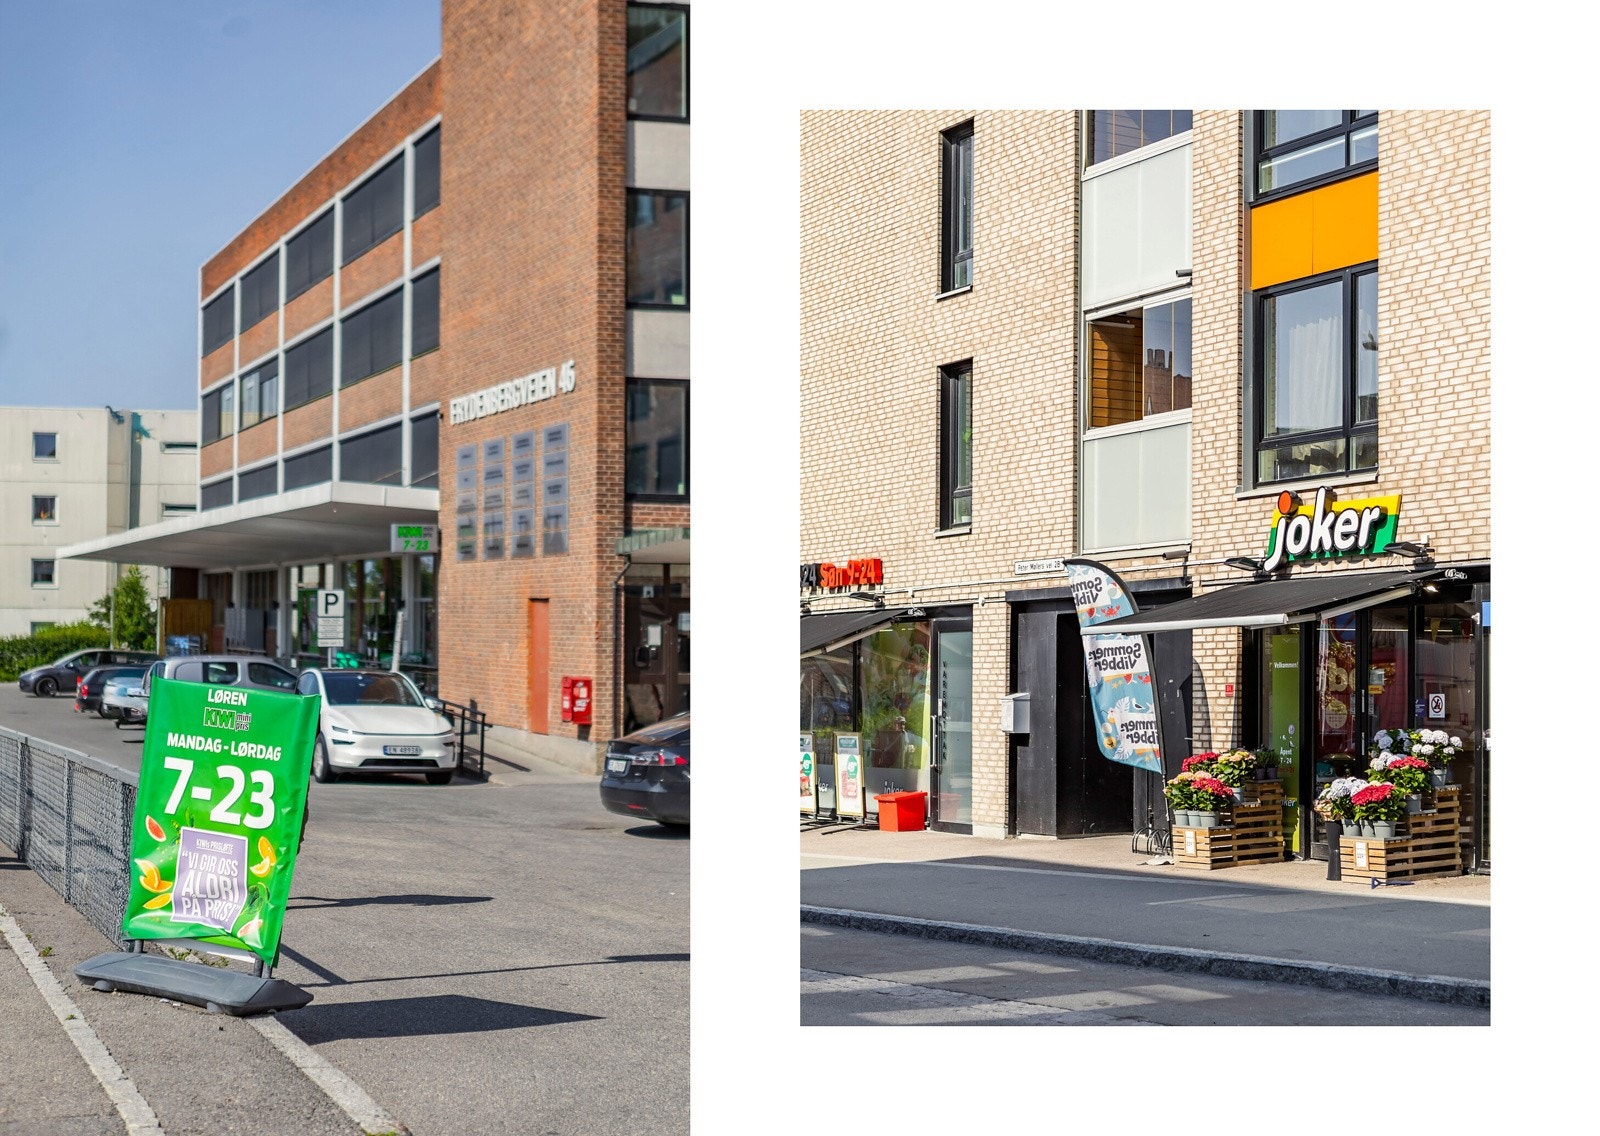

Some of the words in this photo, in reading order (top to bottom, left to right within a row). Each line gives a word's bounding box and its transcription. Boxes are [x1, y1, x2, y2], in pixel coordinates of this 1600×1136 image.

[1264, 486, 1381, 572] joker
[820, 562, 843, 588] Søn
[847, 558, 876, 585] 9-24
[325, 593, 339, 614] P
[207, 688, 248, 707] LØREN
[203, 706, 237, 731] KIWI
[236, 711, 252, 723] mini
[235, 721, 250, 732] pris
[166, 732, 222, 754] MANDAG
[230, 740, 282, 762] LØRDAG
[163, 756, 276, 830] 7-23
[217, 857, 239, 877] OSS
[181, 868, 240, 904] ALDRI
[181, 892, 202, 918] PÅ
